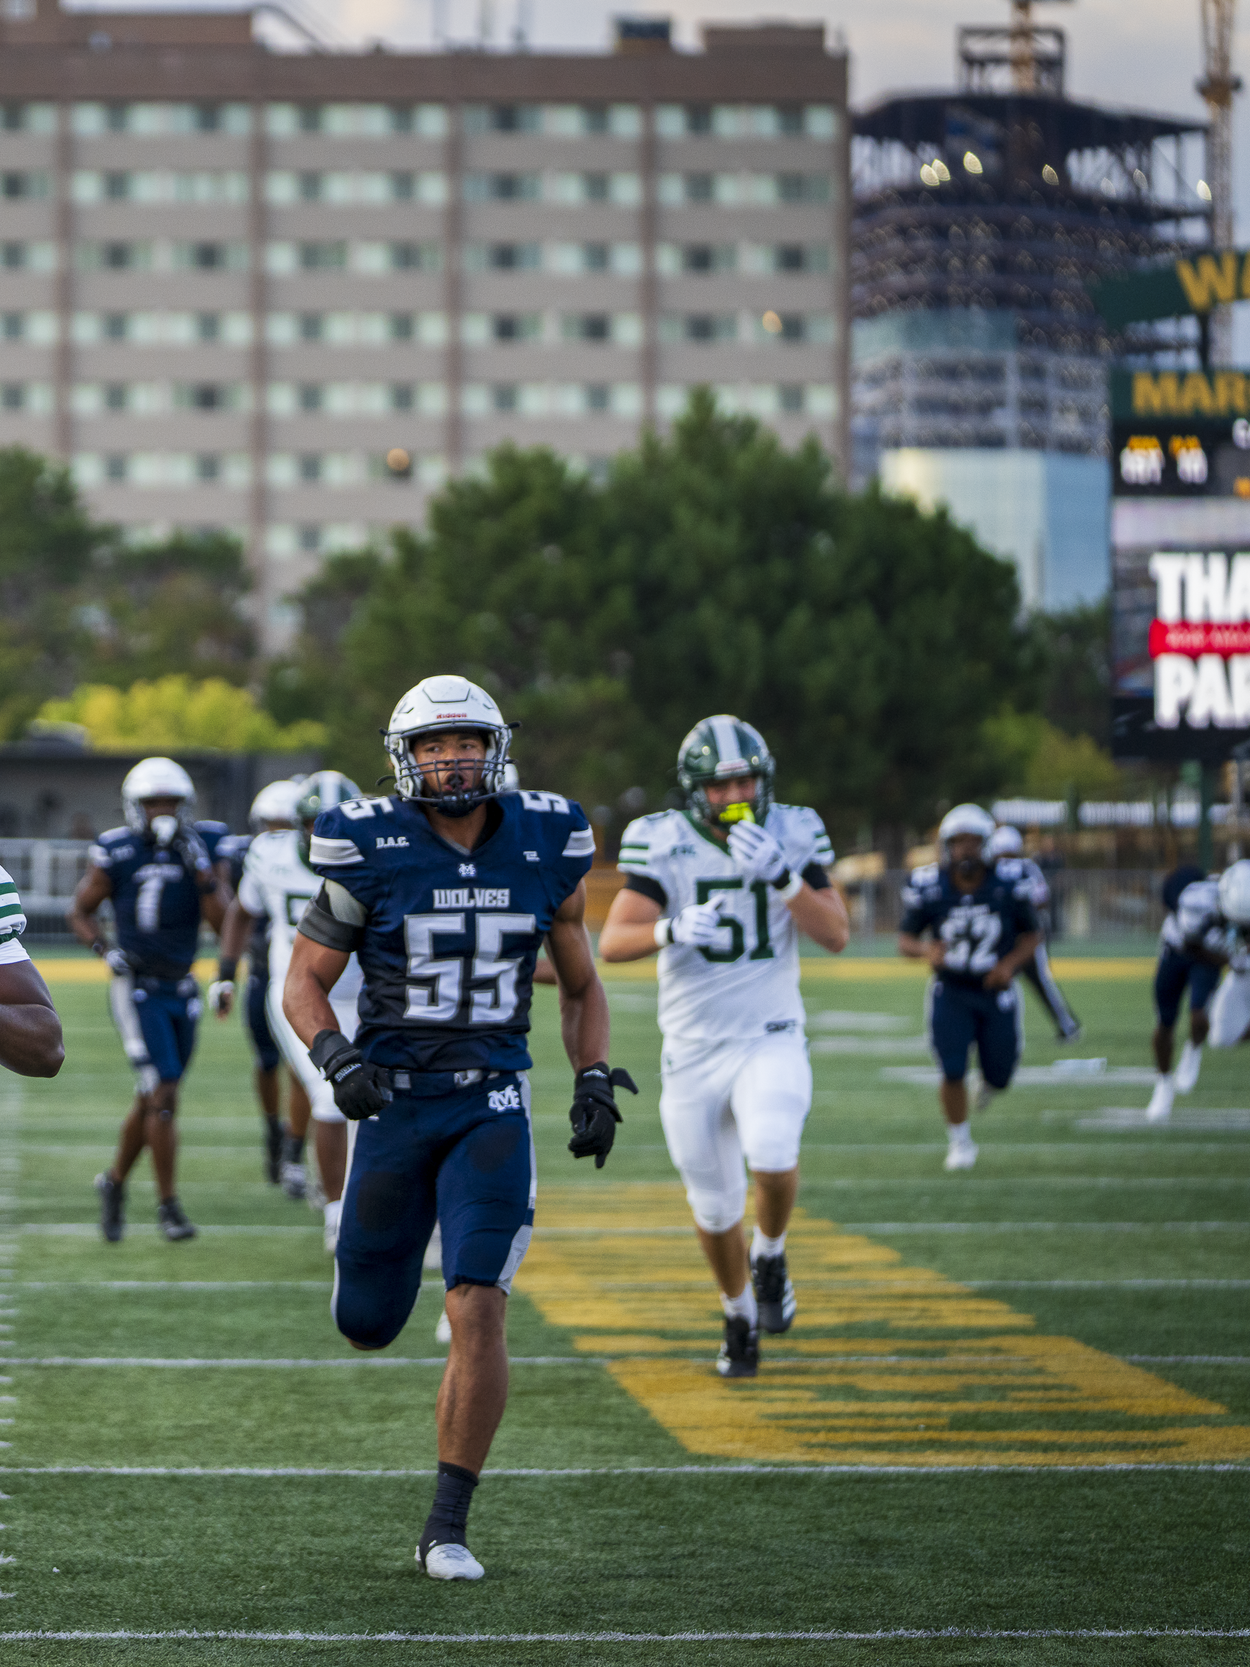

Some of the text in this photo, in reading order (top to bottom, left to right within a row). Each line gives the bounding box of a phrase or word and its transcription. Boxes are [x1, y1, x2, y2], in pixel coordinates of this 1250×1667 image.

[1175, 250, 1250, 311] W
[433, 888, 510, 909] WOLVES
[696, 878, 774, 963] 51
[402, 912, 537, 1024] 55
